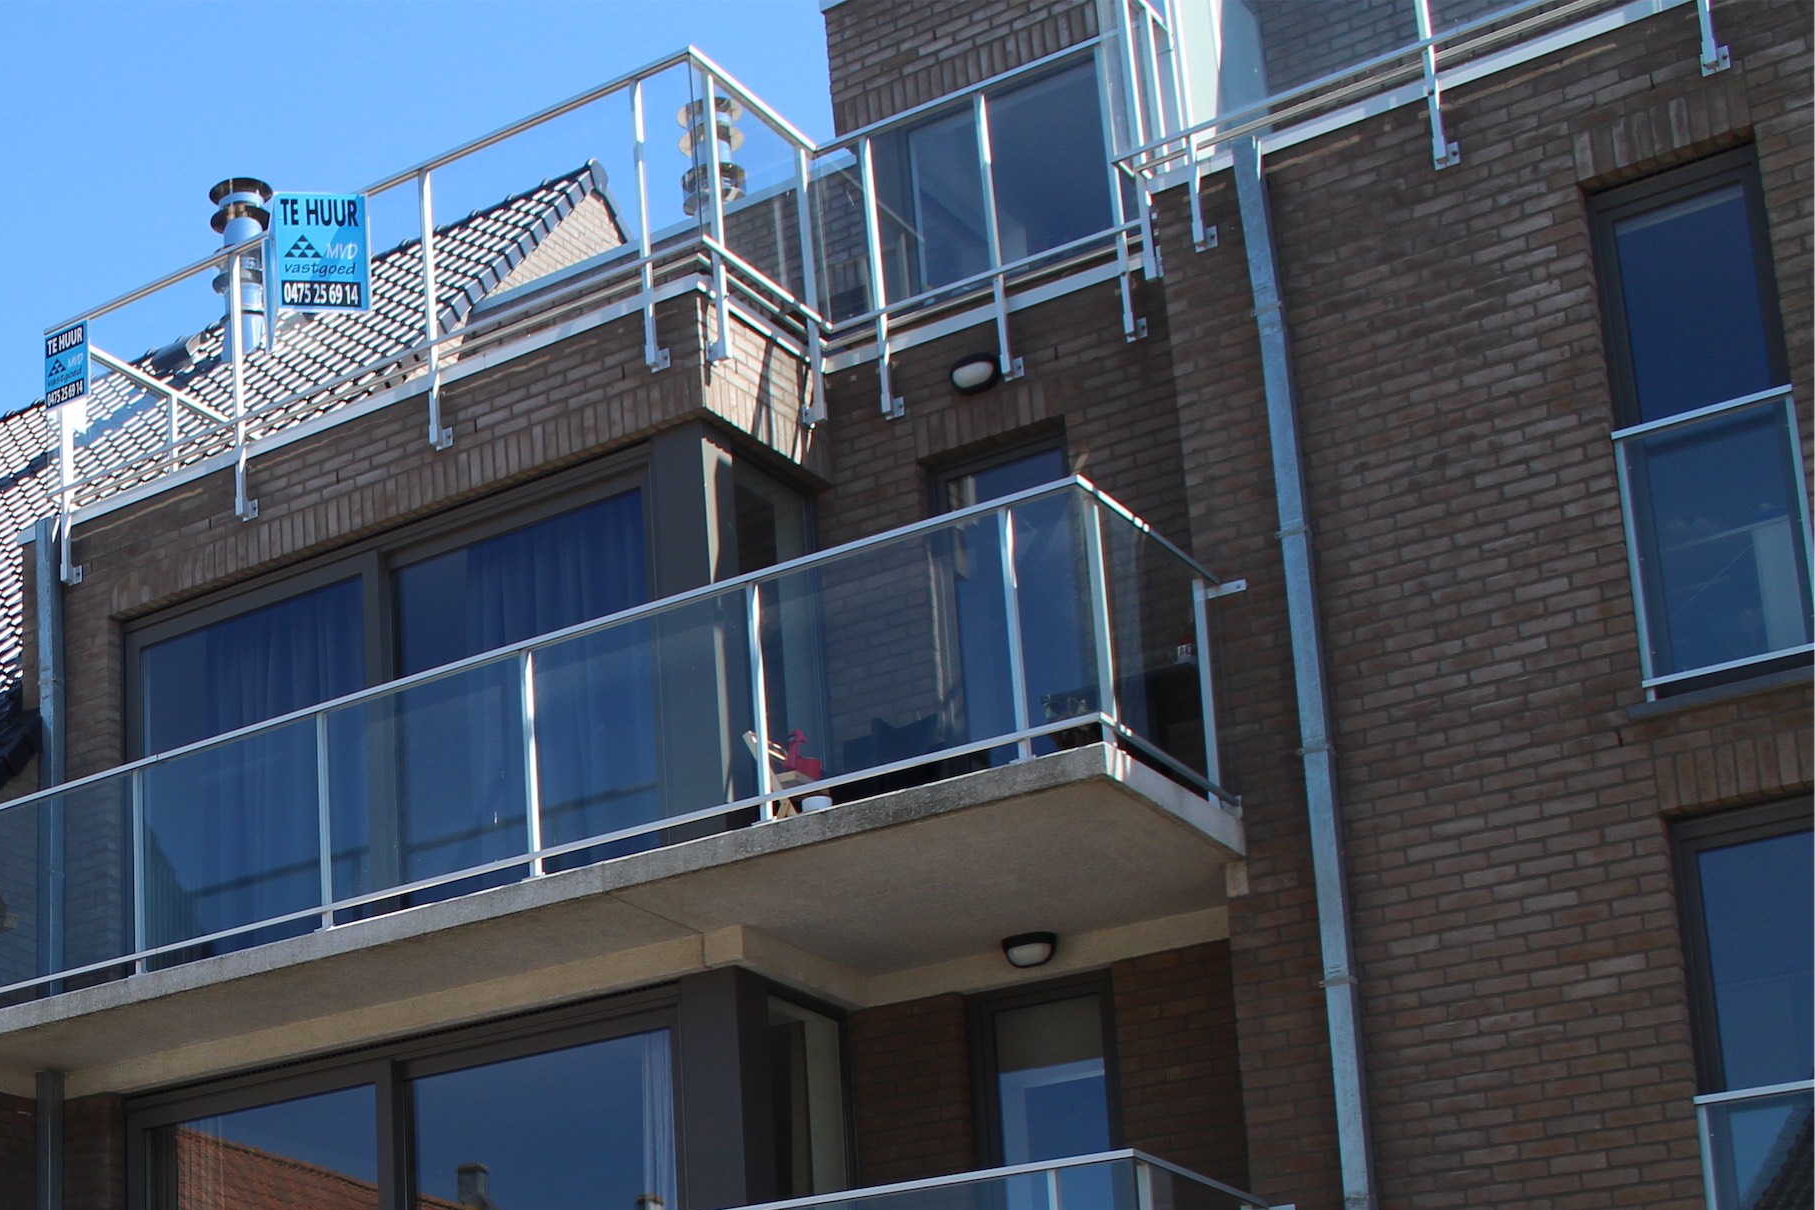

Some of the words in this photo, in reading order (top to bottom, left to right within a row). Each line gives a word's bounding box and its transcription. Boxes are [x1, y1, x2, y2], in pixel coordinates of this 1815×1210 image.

[280, 199, 299, 226] TE
[305, 199, 359, 227] HUUR
[327, 243, 358, 260] MVD
[284, 262, 356, 278] vastgoed
[284, 282, 311, 304] 0475
[313, 283, 327, 304] 25
[328, 283, 343, 305] 69
[345, 284, 359, 305] 14
[47, 338, 58, 356] TE
[58, 326, 83, 352] HUUR
[47, 387, 61, 407] 0475
[61, 385, 68, 402] 25
[68, 382, 76, 399] 69
[76, 380, 84, 395] 14
